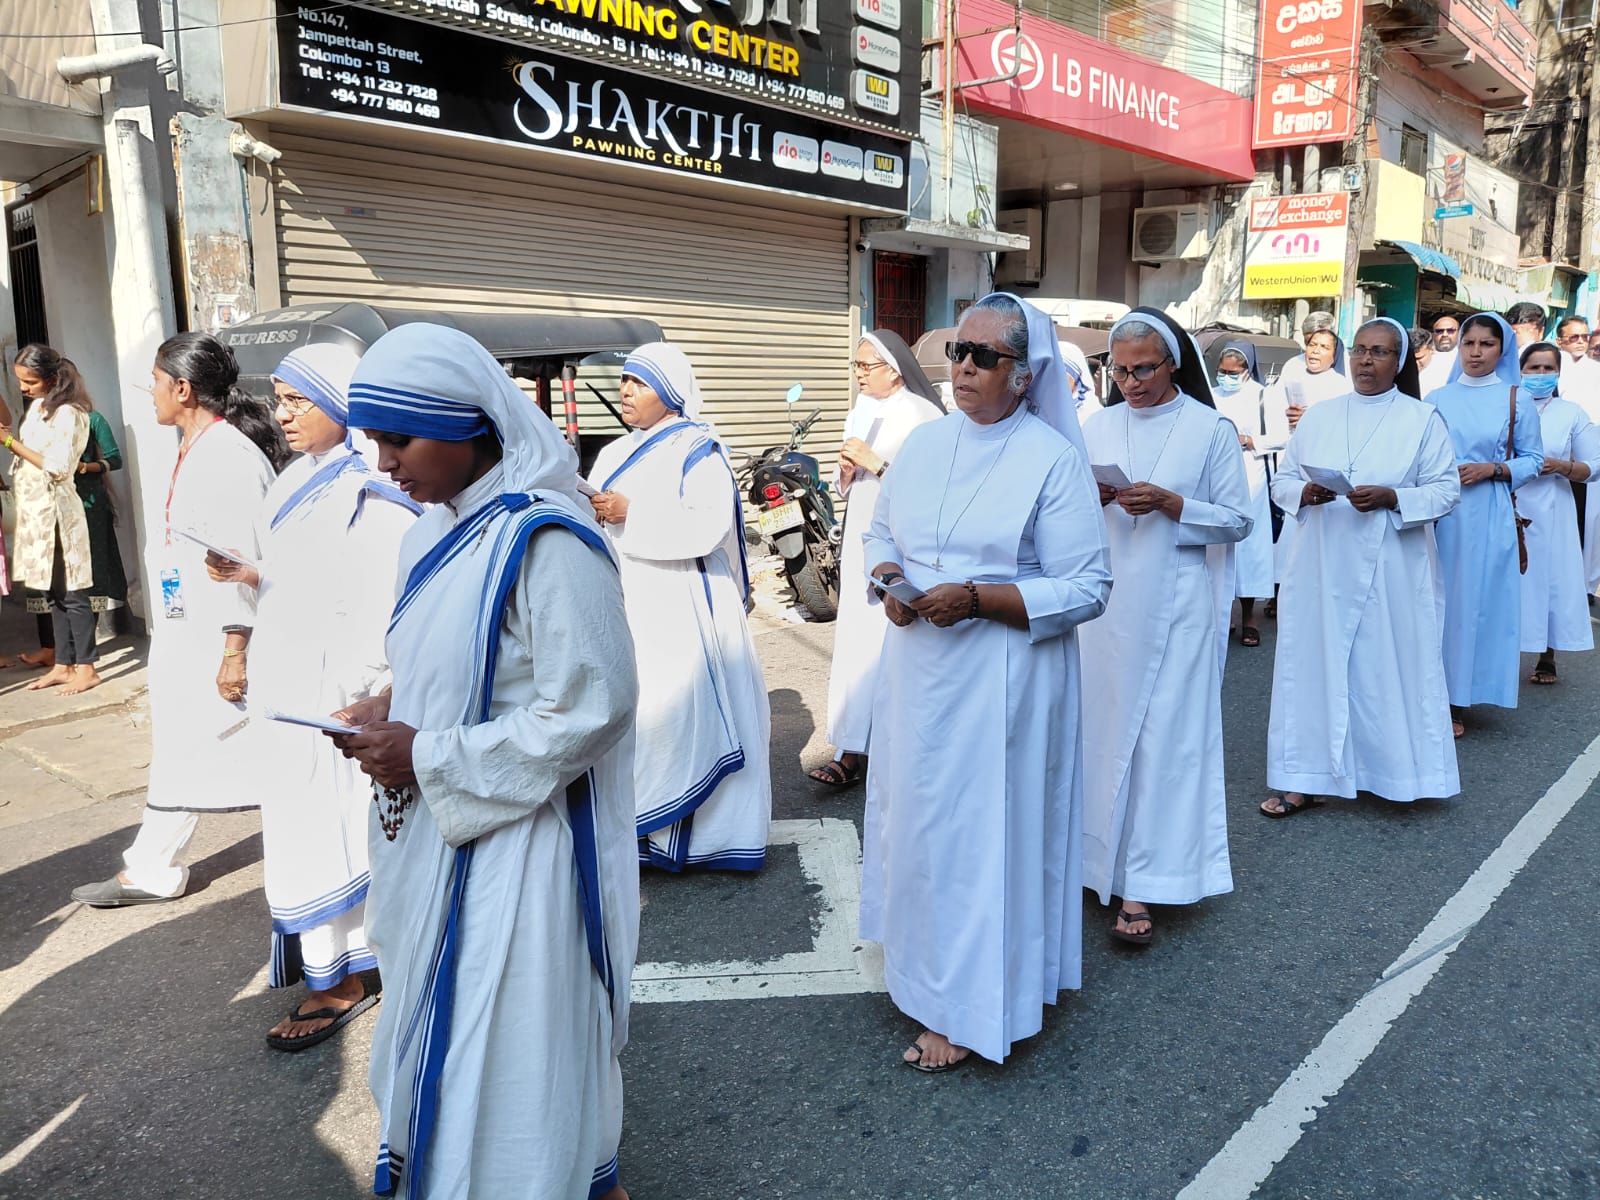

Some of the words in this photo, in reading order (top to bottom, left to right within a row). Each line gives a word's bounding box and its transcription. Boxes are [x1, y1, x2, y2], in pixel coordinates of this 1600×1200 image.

[298, 6, 348, 30] No.147,
[298, 25, 374, 53] Jampettah
[377, 42, 423, 64] Street,
[299, 44, 363, 68] Colombo
[376, 61, 390, 74] 13
[486, 2, 539, 32] Street,
[541, 18, 600, 46] Colombo
[612, 36, 626, 52] 13
[691, 58, 701, 72] 11
[704, 62, 726, 79] 232
[729, 68, 756, 86] 7928
[766, 79, 786, 94] +94
[787, 83, 806, 99] 777
[807, 89, 825, 105] 960
[826, 95, 845, 110] 469
[690, 20, 800, 76] CENTER
[334, 71, 361, 87] +94
[363, 76, 375, 89] 11
[378, 78, 403, 95] 232
[405, 84, 438, 101] 7928
[1052, 53, 1082, 98] LB
[1088, 66, 1180, 130] FINANCE
[331, 88, 358, 104] +94
[360, 92, 384, 108] 777
[386, 97, 412, 114] 960
[415, 103, 440, 119] 469
[513, 60, 762, 163] SHAKTHI
[572, 135, 657, 161] PAWNING
[663, 152, 723, 174] CENTER
[778, 139, 798, 160] ria
[1279, 208, 1343, 223] exchange
[1288, 195, 1336, 210] money
[228, 329, 299, 346] EXPRESS
